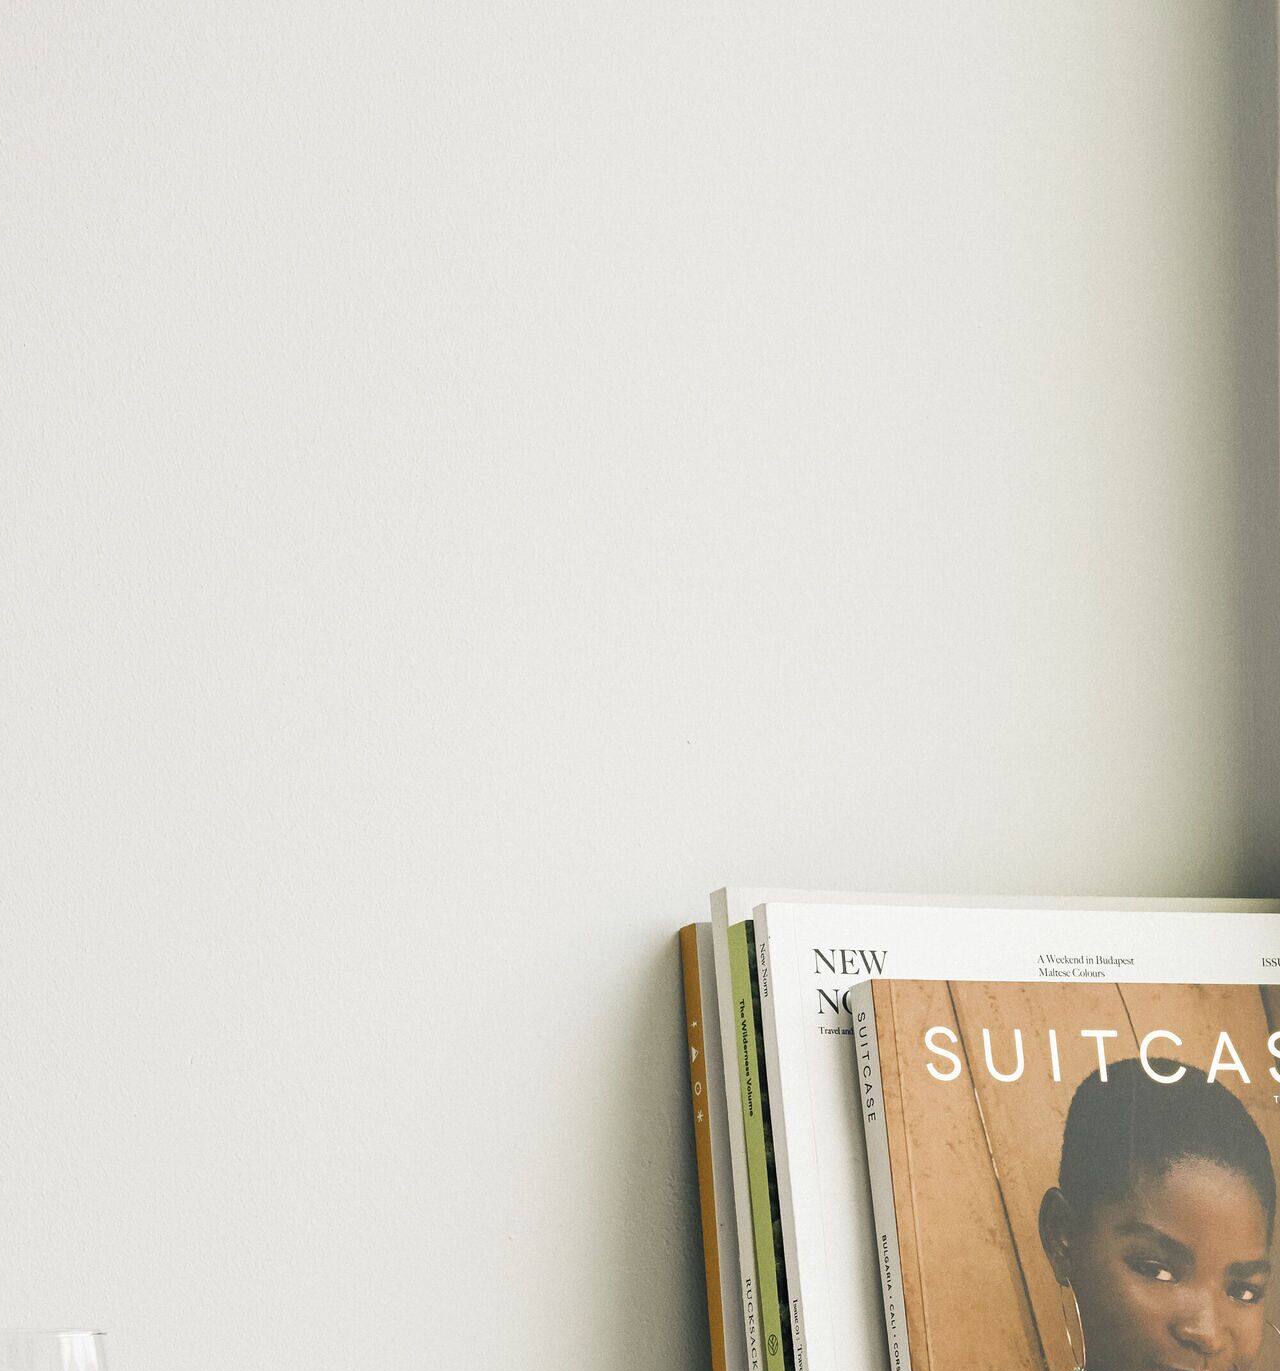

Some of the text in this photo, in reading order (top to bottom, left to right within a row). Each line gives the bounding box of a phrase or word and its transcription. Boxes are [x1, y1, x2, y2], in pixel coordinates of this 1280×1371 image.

[759, 943, 767, 966] New
[812, 948, 888, 975] NEW
[1037, 954, 1134, 967] A Weekend in Budapest
[1038, 967, 1106, 978] Maltese Colours
[818, 1026, 840, 1035] Travel
[738, 998, 754, 1117] The Wilderness Volume
[857, 1011, 877, 1124] SUITCASE
[881, 1234, 893, 1292] BULGARIA
[889, 1303, 897, 1330] CALI
[745, 1278, 759, 1371] RUCKSACK
